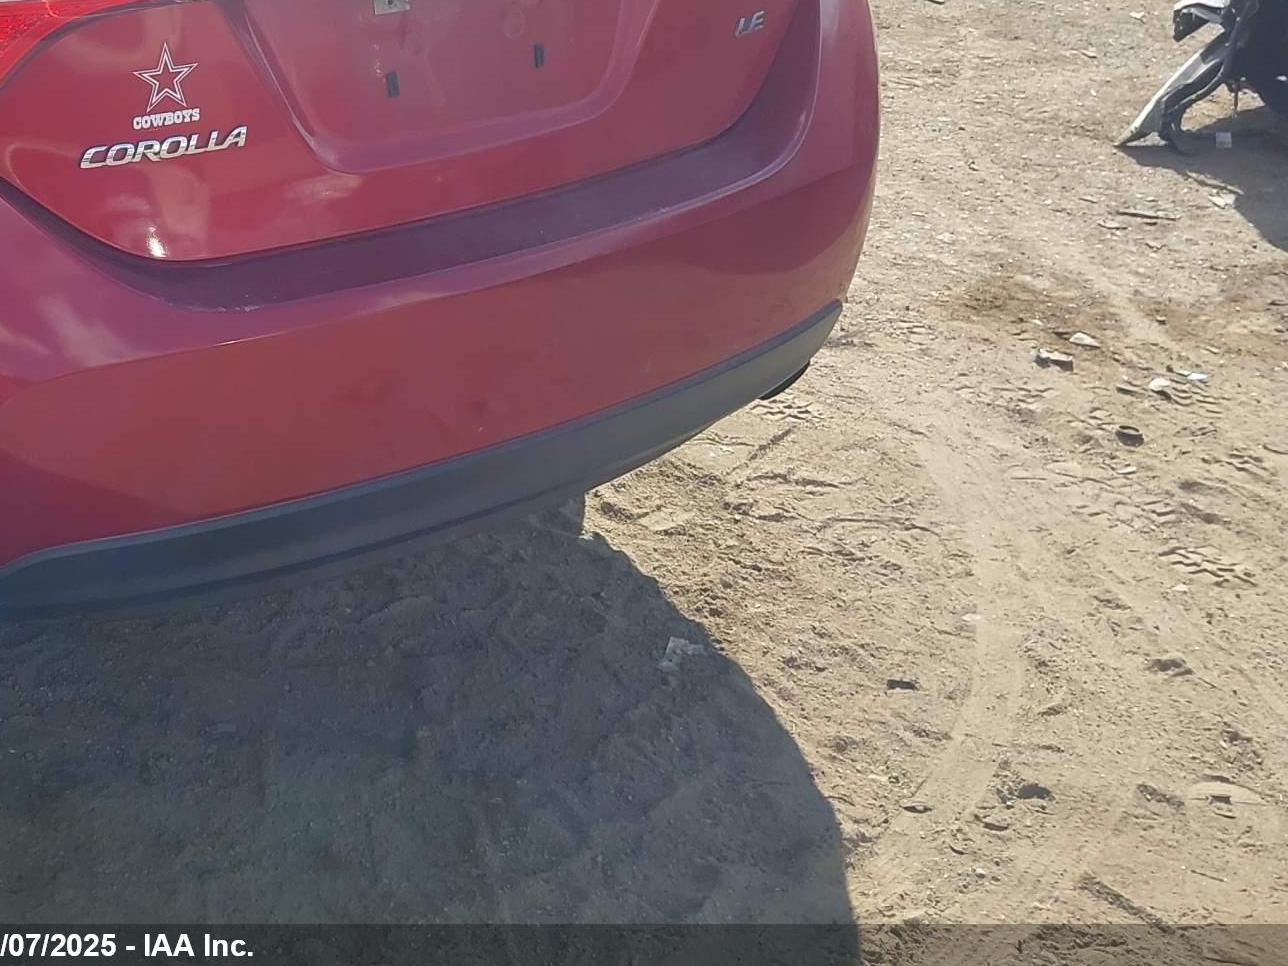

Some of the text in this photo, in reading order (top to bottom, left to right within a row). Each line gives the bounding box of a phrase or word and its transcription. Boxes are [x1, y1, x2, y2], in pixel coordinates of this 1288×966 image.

[735, 10, 765, 38] LE
[133, 108, 200, 129] COWBOYS
[80, 126, 247, 168] COROLLA
